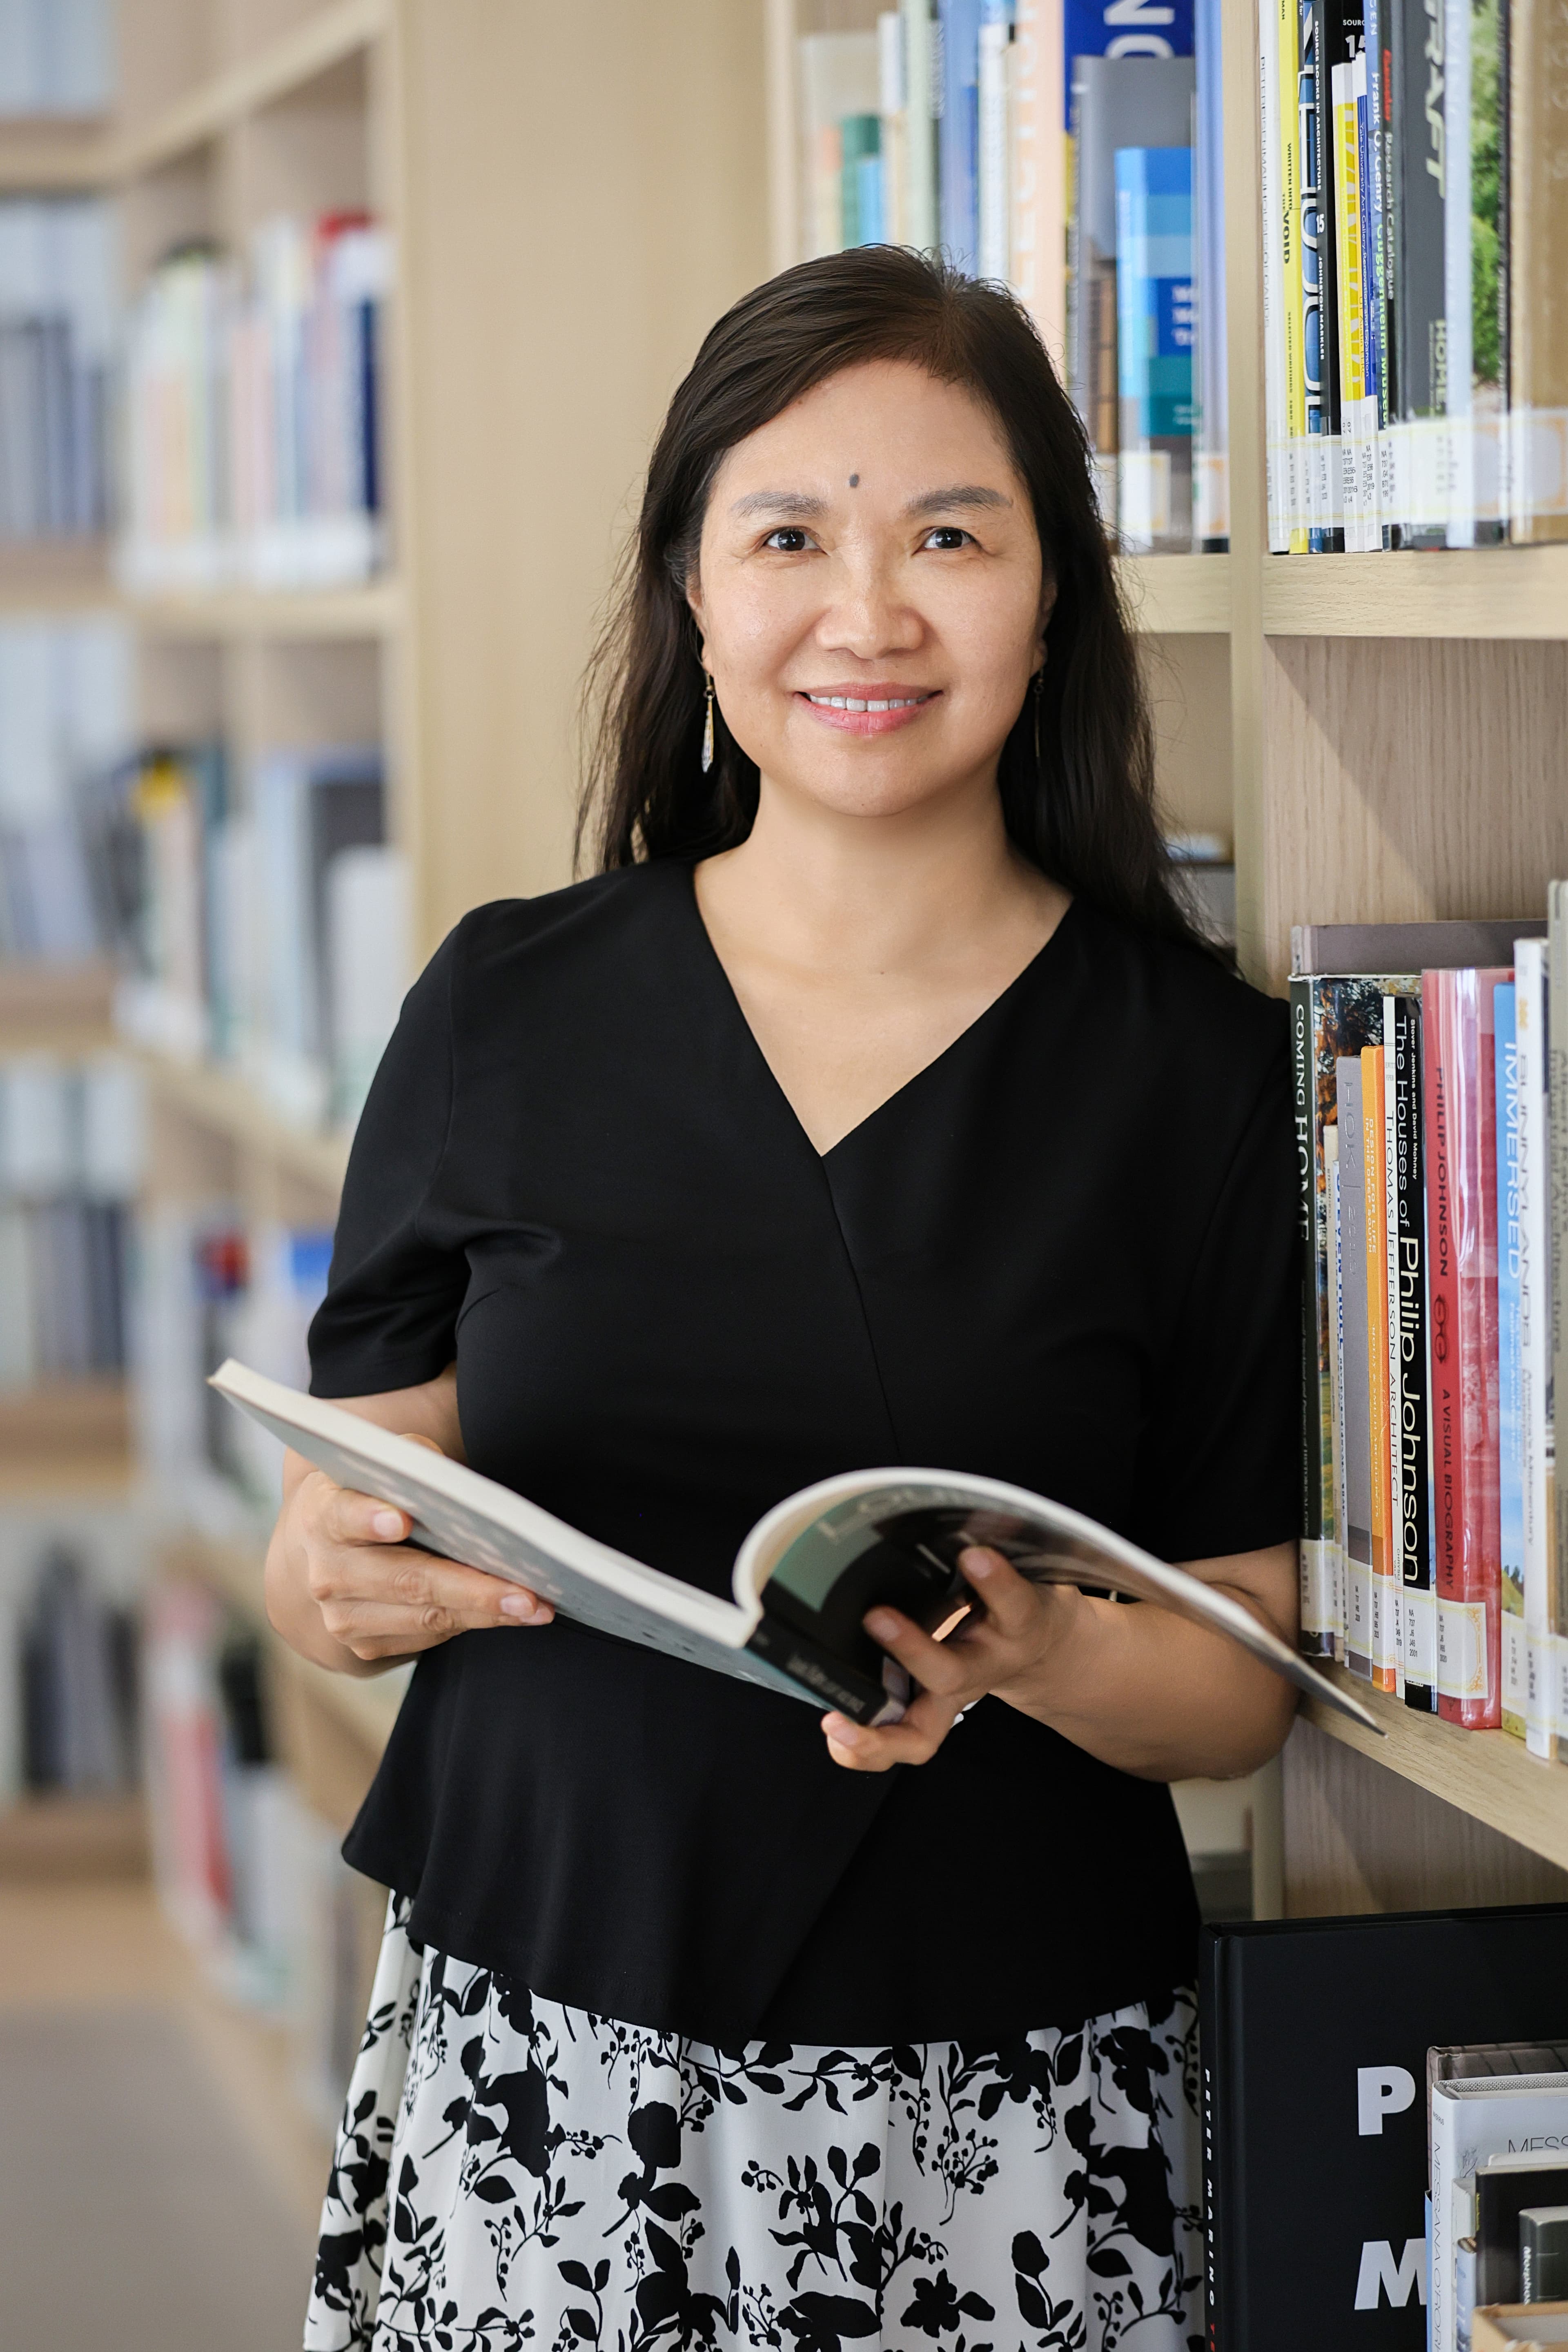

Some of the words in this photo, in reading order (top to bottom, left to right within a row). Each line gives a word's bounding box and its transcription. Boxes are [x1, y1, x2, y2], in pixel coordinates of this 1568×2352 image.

[1316, 102, 1321, 113] IN
[1371, 72, 1380, 125] Frank
[1373, 154, 1383, 213] Gehry
[1385, 131, 1394, 209] Research
[1316, 214, 1325, 233] 15
[1385, 212, 1395, 300] Catalogue
[1376, 224, 1387, 349] Guggenheim
[1296, 1004, 1305, 1106] COMING
[1396, 1015, 1408, 1070] The
[1344, 1082, 1356, 1169] HOK
[1365, 1117, 1370, 1131] IN
[1397, 1080, 1408, 1191] Houses
[1436, 1067, 1446, 1147] PHILIP
[1506, 1042, 1520, 1279] IMMERSED
[1399, 1200, 1410, 1227] of
[1438, 1151, 1448, 1276] JOHNSON
[1388, 1229, 1397, 1360] JEFFERSON
[1400, 1237, 1420, 1362] Philip
[1443, 1389, 1450, 1401] A
[1390, 1372, 1399, 1507] ARCHITECT
[1443, 1401, 1452, 1469] VISUAL
[1403, 1372, 1421, 1581] Johnson
[1443, 1474, 1454, 1590] BIOGRAPHY
[1408, 1608, 1414, 1617] NA
[1410, 1649, 1418, 1658] 2001
[1205, 2068, 1213, 2161] PETER
[1357, 2065, 1416, 2136] P
[1354, 2238, 1427, 2310] M
